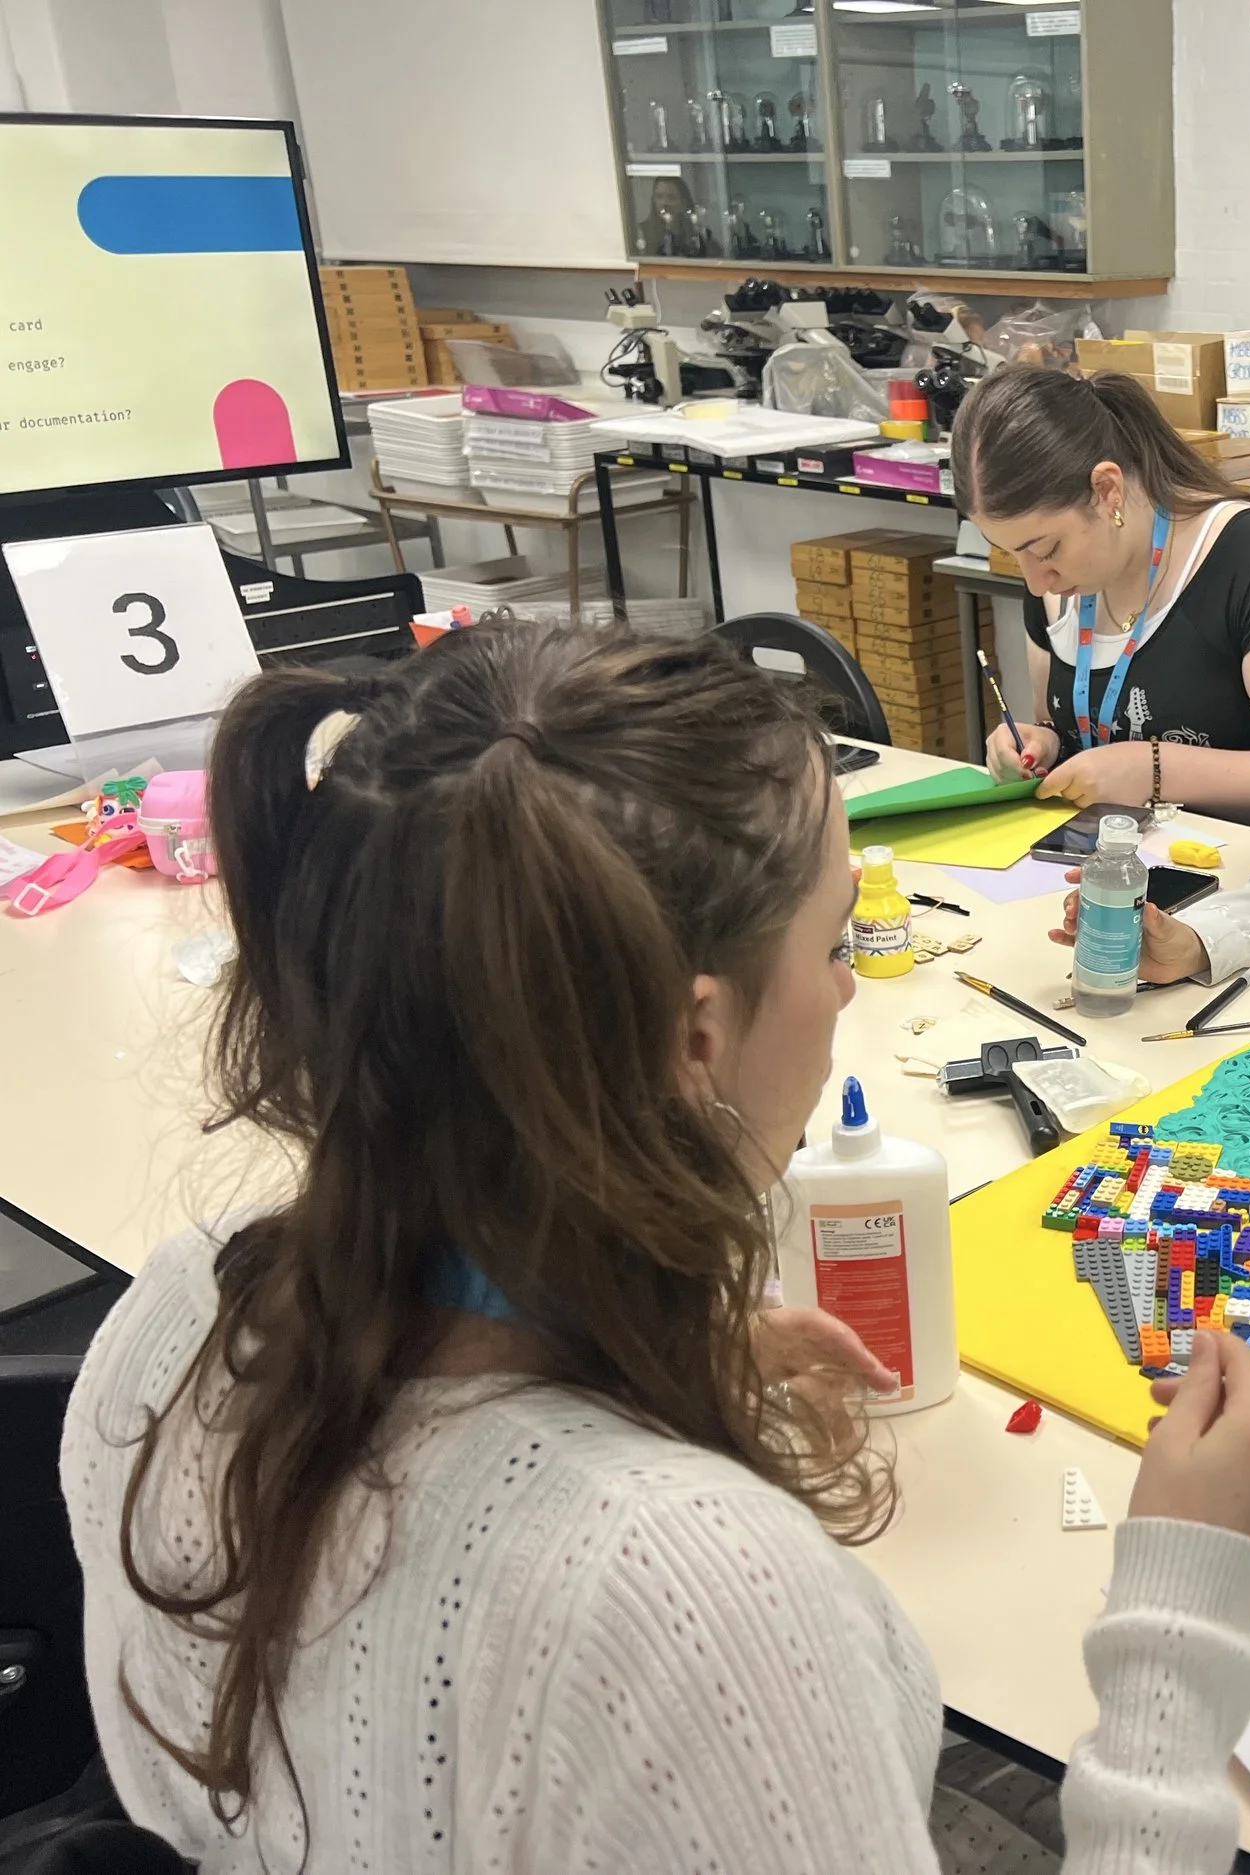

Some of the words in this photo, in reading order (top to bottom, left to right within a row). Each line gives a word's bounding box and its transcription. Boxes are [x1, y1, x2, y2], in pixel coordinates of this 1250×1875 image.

[9, 319, 43, 331] card
[8, 356, 65, 373] engage?
[19, 409, 132, 429] documentation?
[112, 592, 180, 675] 3
[876, 934, 898, 943] Paint
